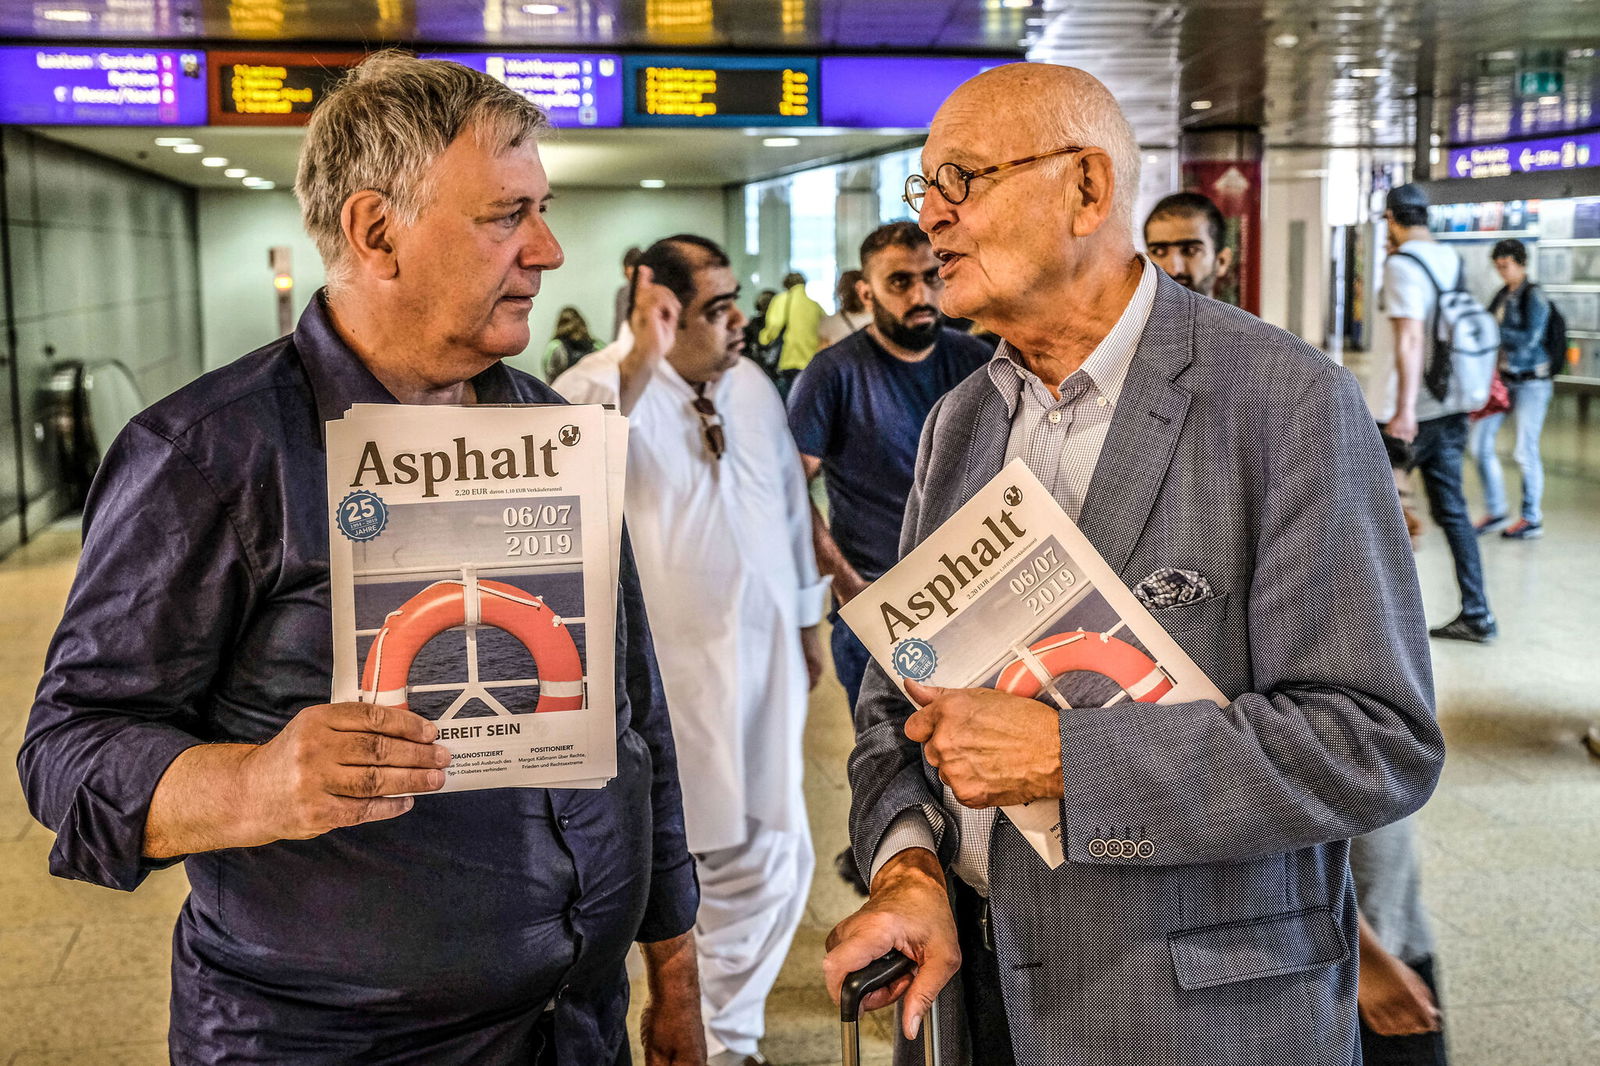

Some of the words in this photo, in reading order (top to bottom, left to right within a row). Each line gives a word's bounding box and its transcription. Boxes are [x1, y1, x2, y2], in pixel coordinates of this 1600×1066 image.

[349, 434, 559, 498] Asphalt
[346, 498, 375, 522] 25
[502, 505, 572, 528] 06/07
[355, 525, 377, 536] JAHRE
[506, 533, 573, 557] 2019
[879, 509, 1027, 645] Asphalt
[1009, 546, 1060, 595] 06/07
[1026, 569, 1077, 617] 2019
[899, 643, 923, 670] 25
[486, 723, 521, 737] SEIN
[530, 744, 575, 753] POSITIONIERT
